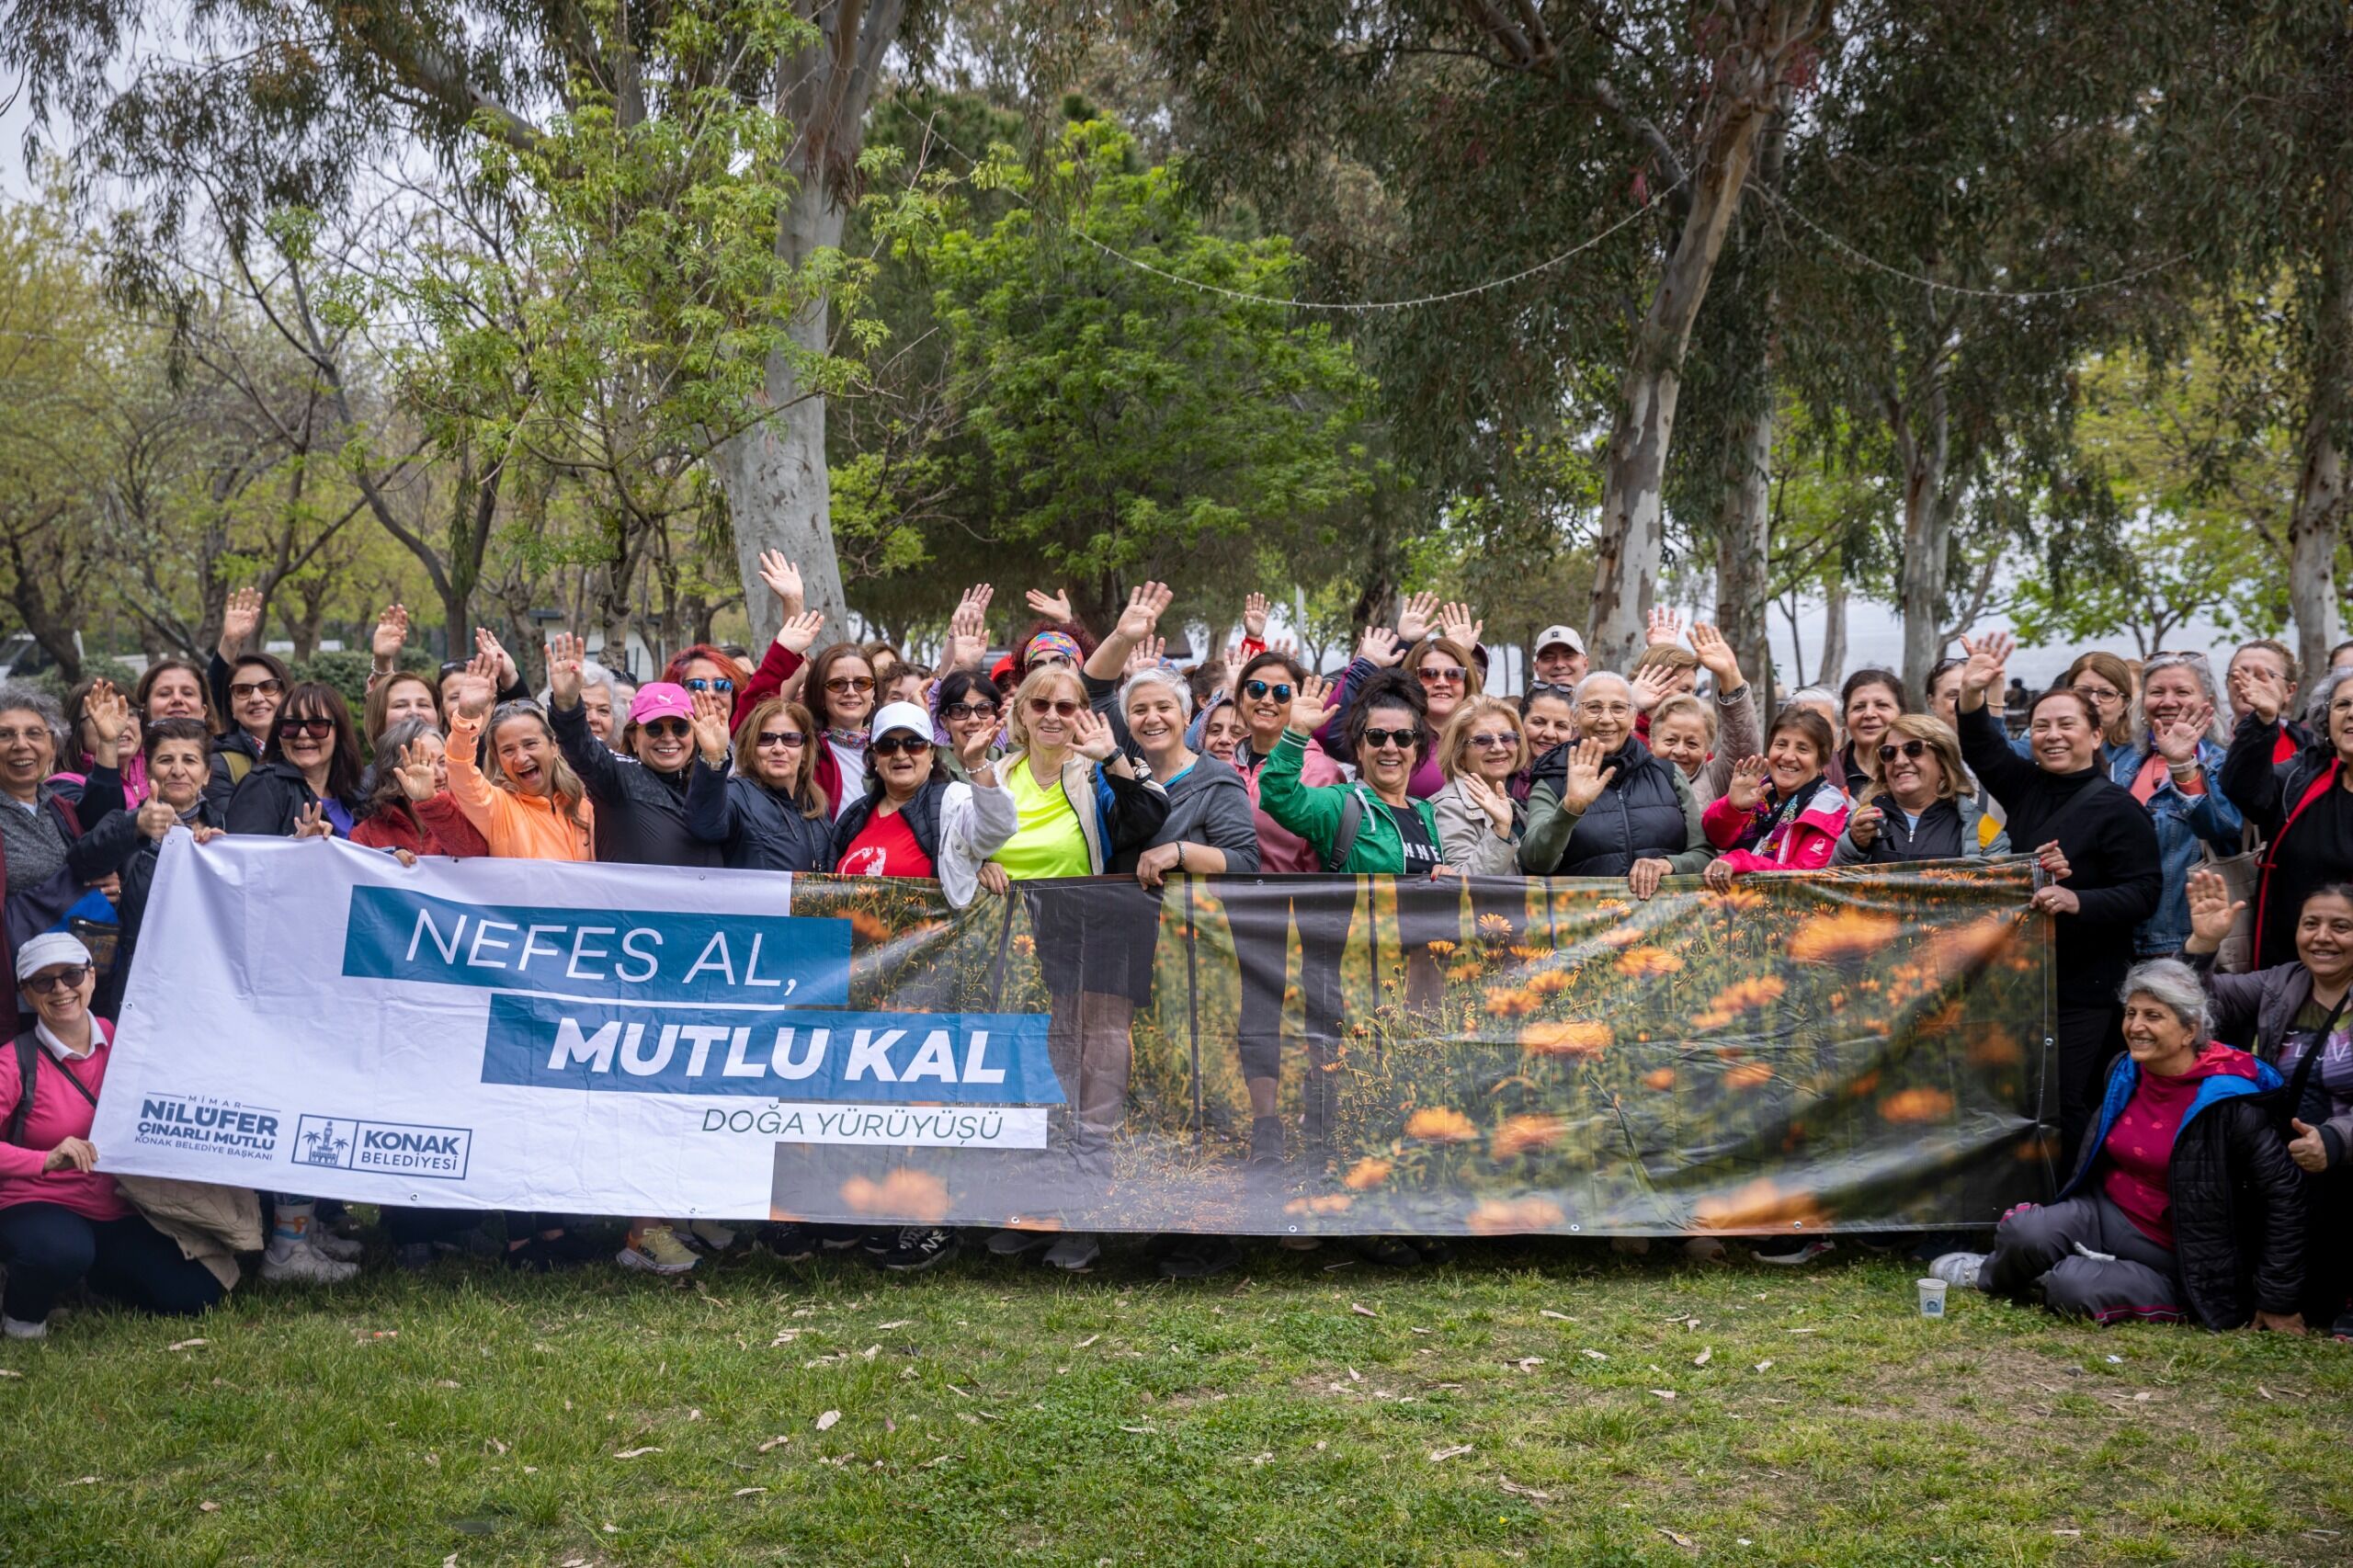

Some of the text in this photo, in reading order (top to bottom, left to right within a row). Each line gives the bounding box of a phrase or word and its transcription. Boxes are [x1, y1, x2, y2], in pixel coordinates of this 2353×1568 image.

[405, 907, 798, 996] NEFES AL,
[547, 1017, 1006, 1084] MUTLU KAL
[188, 1095, 242, 1108] MİMAR
[137, 1120, 276, 1151] ÇINARLI MUTLU
[701, 1104, 1004, 1146] DOĞA YÜRÜYÜŞÜ
[134, 1135, 273, 1162] KONAK BELEDİYE BAŞKANI
[364, 1130, 460, 1155] KONAK
[361, 1151, 458, 1170] BELEDİYESİ
